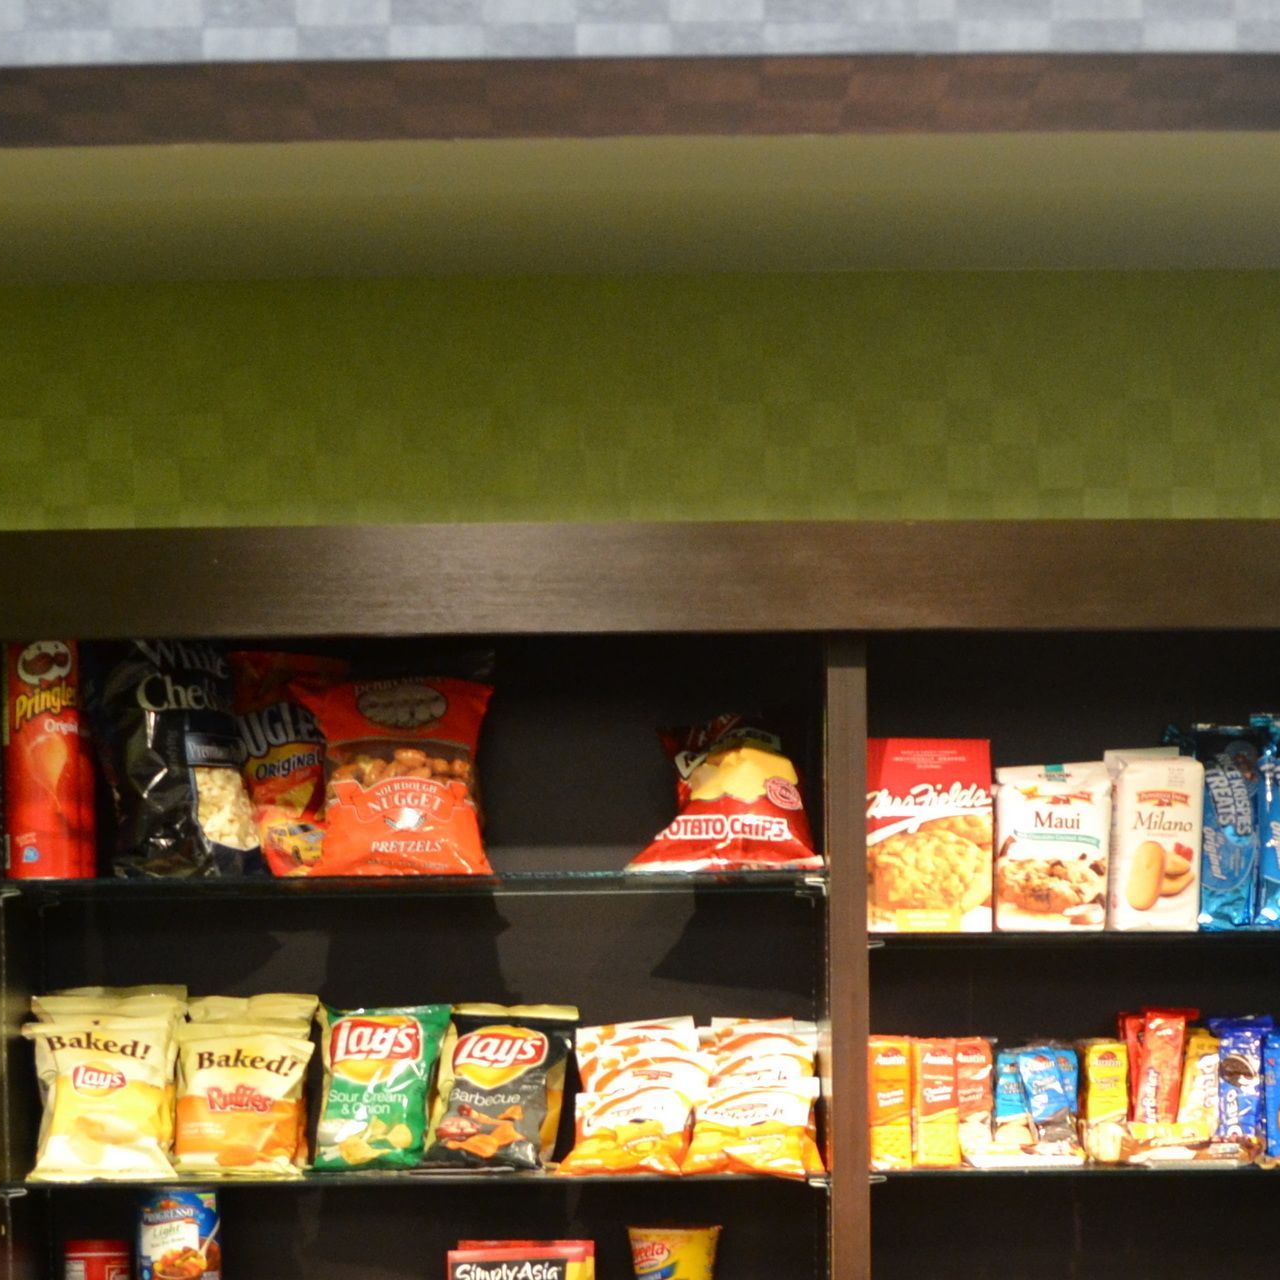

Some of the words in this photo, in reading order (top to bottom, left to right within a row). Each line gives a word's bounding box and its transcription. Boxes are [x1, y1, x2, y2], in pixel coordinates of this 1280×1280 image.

[368, 791, 447, 813] NUGGET
[1205, 770, 1234, 826] TREATS
[730, 814, 790, 841] CHIPS
[1034, 811, 1081, 830] Maui
[1133, 810, 1193, 833] Milano
[371, 839, 442, 853] PRETZELS
[1204, 826, 1227, 882] Original
[46, 1032, 151, 1060] Baked!
[333, 1016, 421, 1060] Lay's
[454, 1030, 546, 1066] Lay's
[197, 1048, 299, 1077] Baked!
[207, 1084, 272, 1112] Ruffles
[329, 1090, 361, 1104] Sour
[363, 1091, 407, 1104] Cream
[353, 1101, 391, 1115] Onion
[450, 1089, 521, 1107] Barbecue
[1227, 1089, 1241, 1137] OREO
[142, 1206, 195, 1224] PROGRESSO
